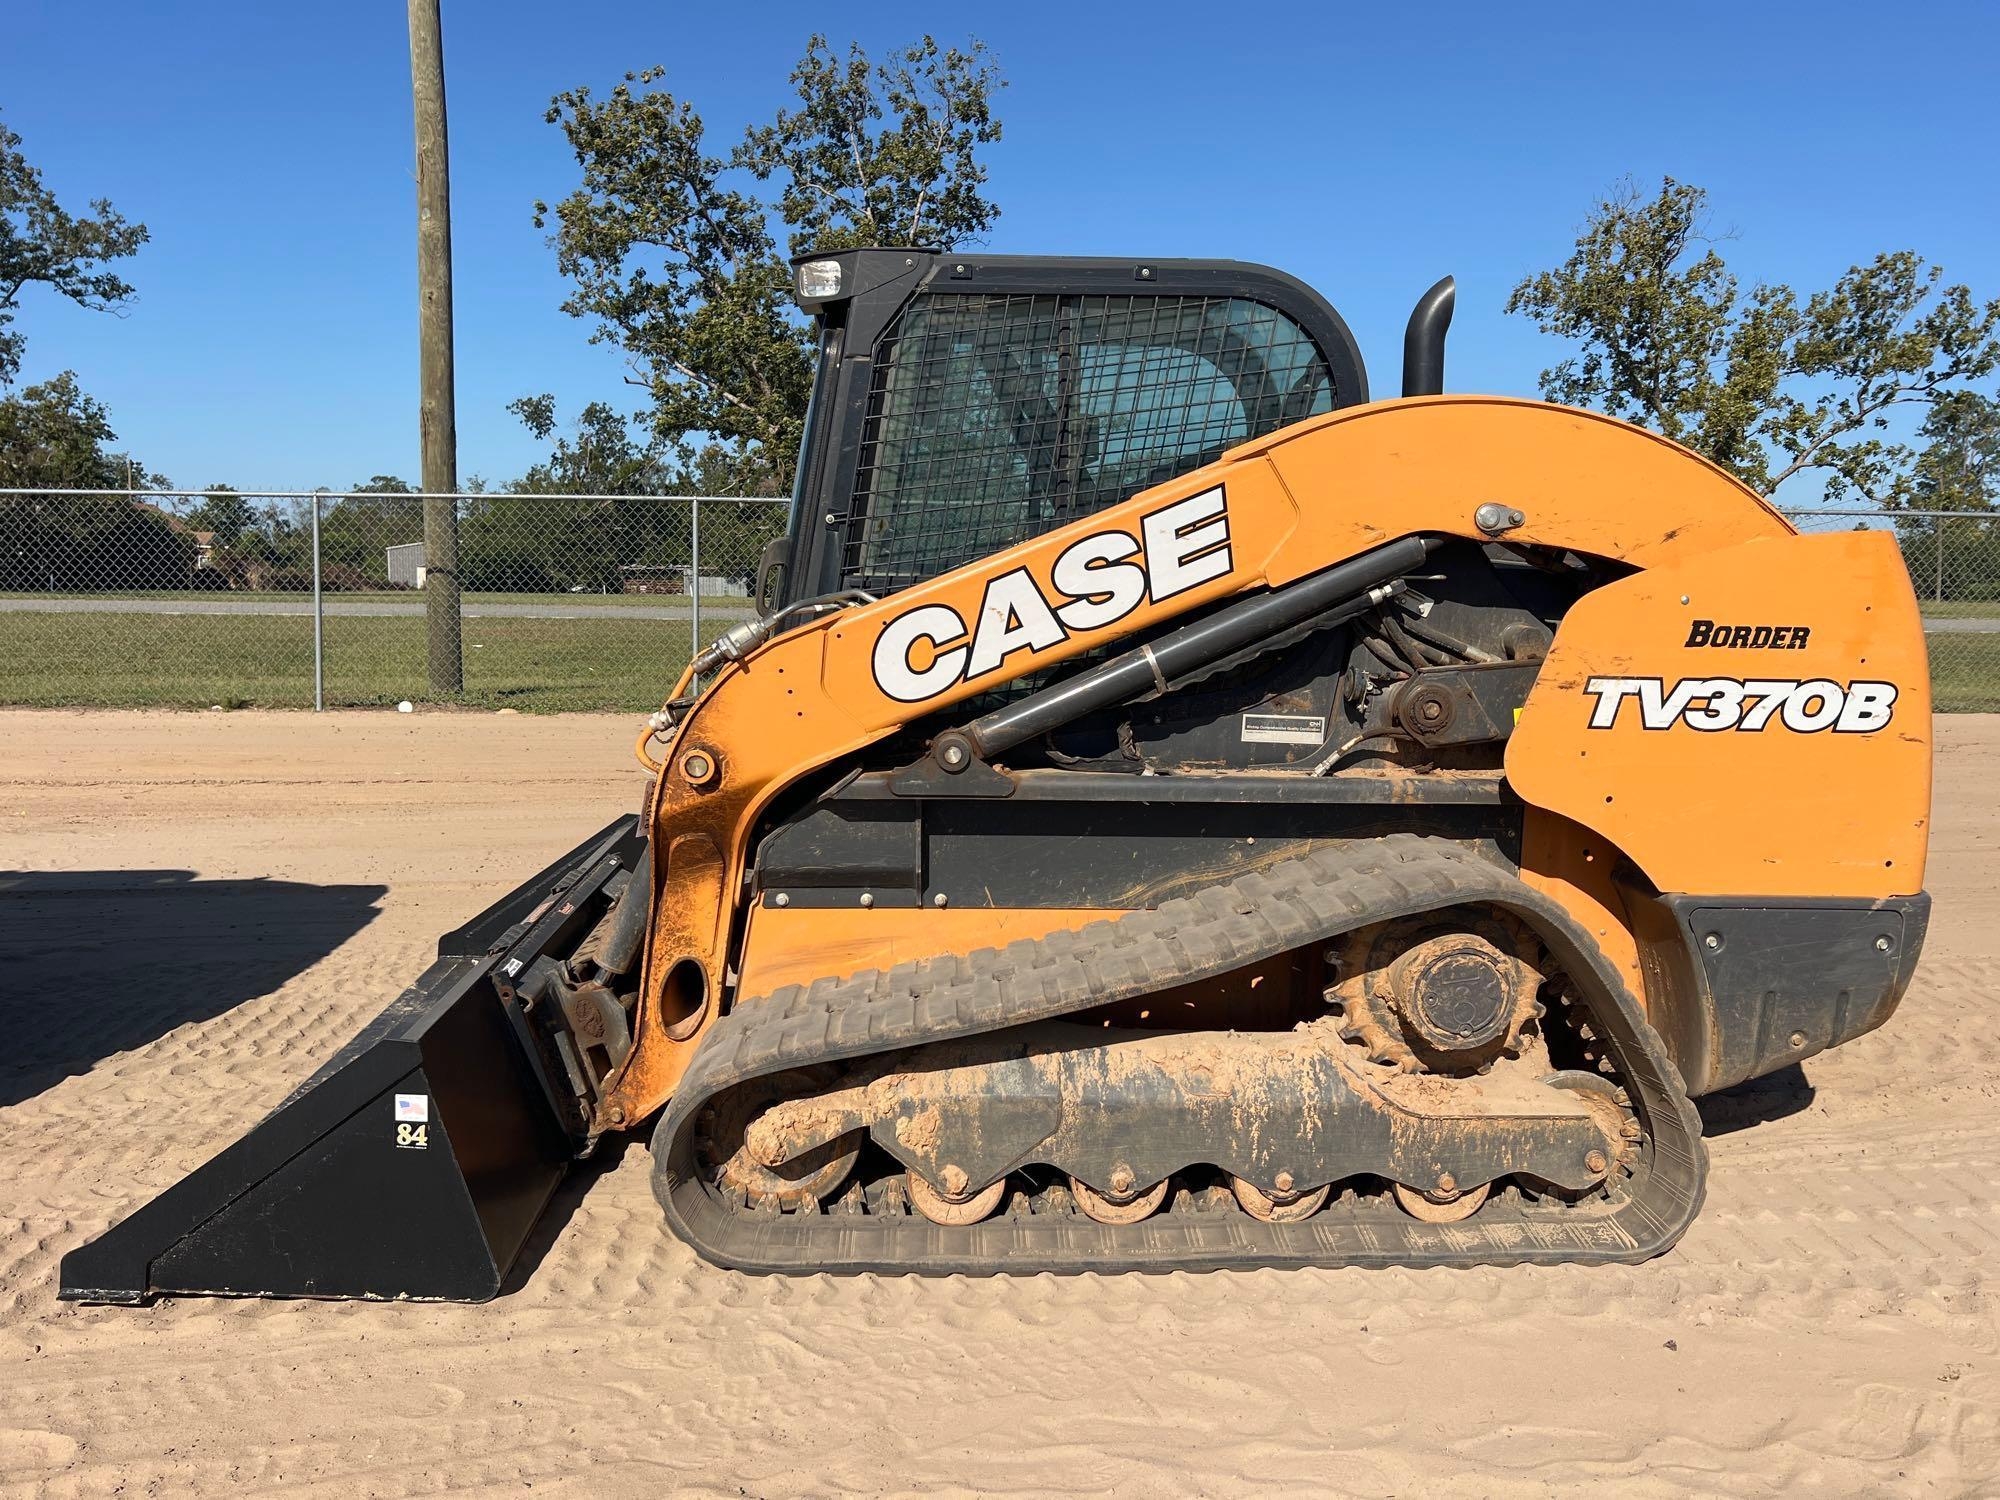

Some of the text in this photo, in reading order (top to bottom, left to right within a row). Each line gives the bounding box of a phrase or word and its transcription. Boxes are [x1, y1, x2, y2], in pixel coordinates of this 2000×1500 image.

[872, 482, 1234, 703] CASE
[1684, 620, 1810, 649] BORDER
[1584, 676, 1898, 733] TV370B
[397, 1123, 428, 1146] 84
